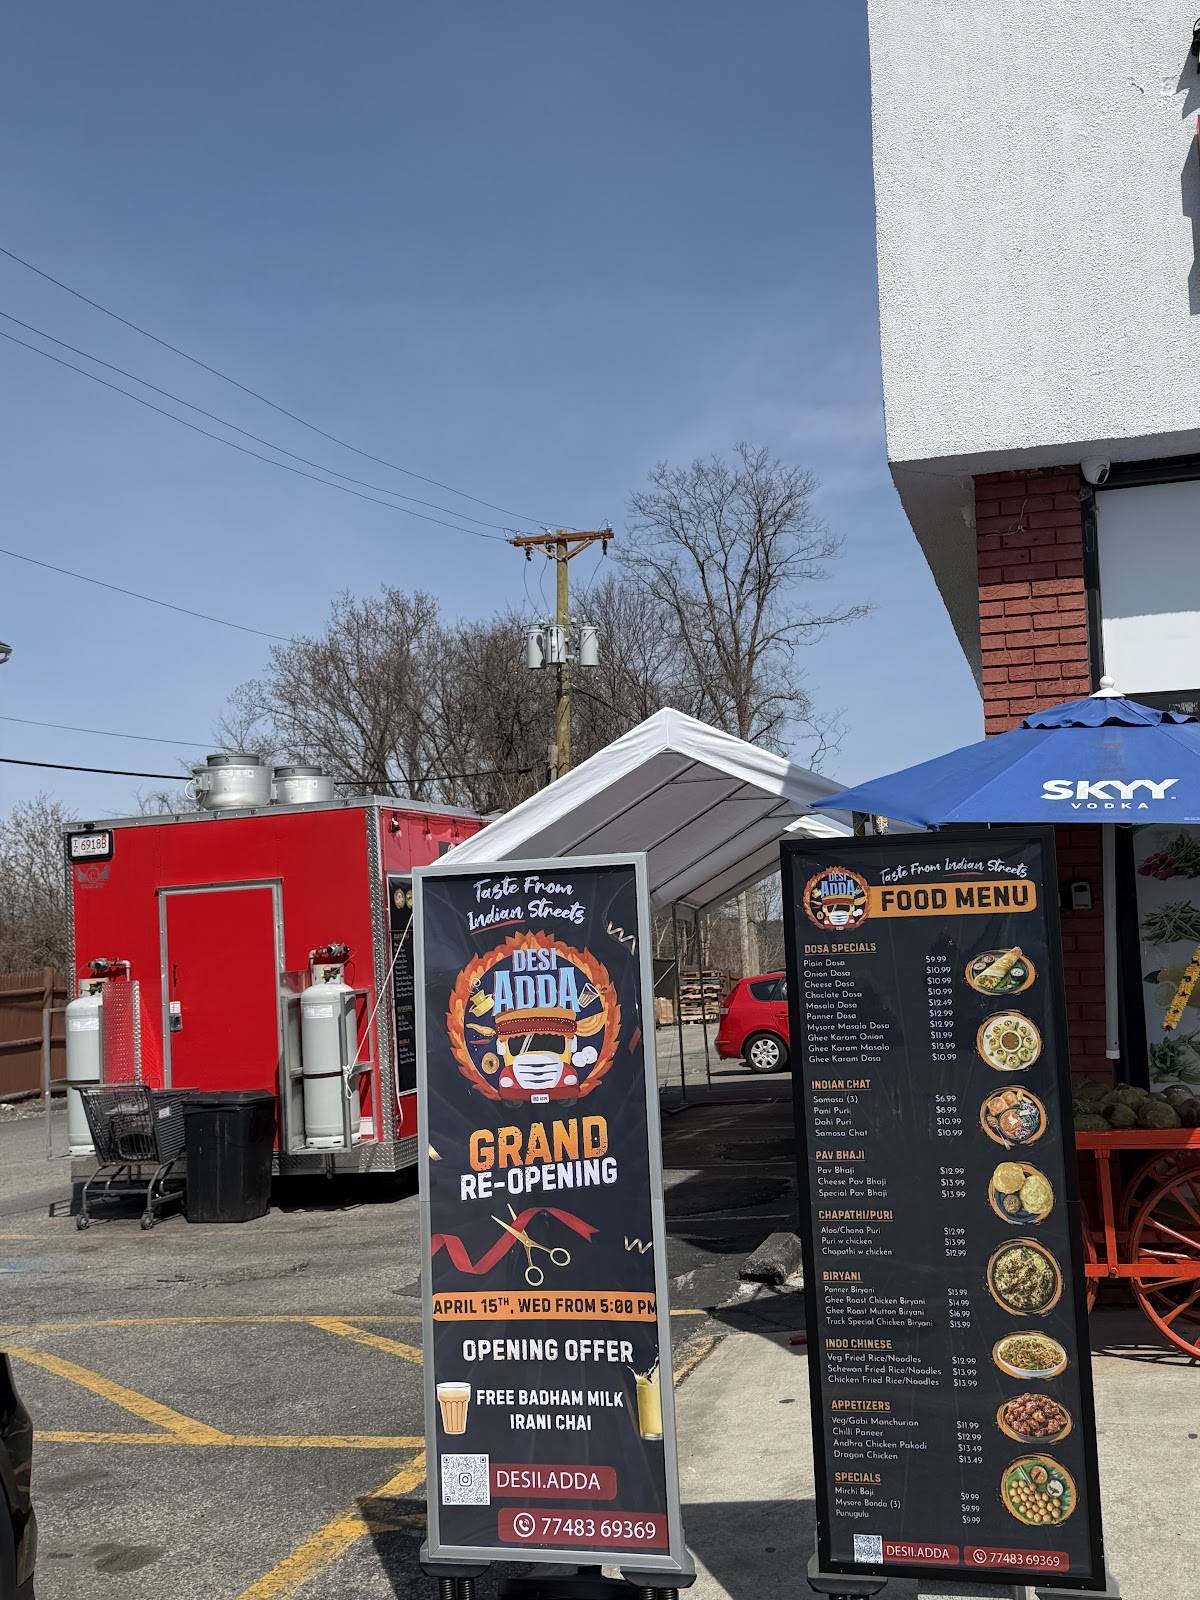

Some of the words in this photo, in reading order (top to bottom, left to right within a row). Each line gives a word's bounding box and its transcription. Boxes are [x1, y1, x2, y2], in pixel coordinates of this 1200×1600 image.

[1040, 778, 1180, 800] SKYY
[880, 866, 908, 885] Taste
[911, 863, 941, 875] From
[944, 858, 984, 871] Indian
[987, 858, 1028, 878] Streets
[828, 873, 848, 882] DESI
[473, 876, 519, 903] Taste
[524, 875, 573, 895] From
[820, 880, 855, 897] ADDA
[881, 889, 947, 911] FOOD
[956, 885, 1028, 908] MENU
[467, 909, 524, 931] Indian
[528, 898, 586, 925] Streets
[805, 945, 829, 954] DOSA
[832, 943, 876, 953] SPECIALS
[512, 948, 557, 973] DESI
[926, 955, 946, 963] $9.99
[926, 966, 950, 974] $10.99
[927, 977, 951, 985] $10.99
[492, 967, 580, 1015] ADDA
[928, 988, 952, 996] $10.99
[808, 1024, 835, 1032] Mysore
[932, 1042, 955, 1050] $12.99
[861, 1054, 880, 1062] Dosa
[933, 1053, 957, 1061] $10.99
[812, 1080, 844, 1089] INDIAN
[847, 1080, 871, 1088] CHAT
[815, 1118, 833, 1126] Dahi
[815, 1129, 845, 1137] Samosa
[849, 1129, 867, 1137] Chat
[938, 1129, 962, 1137] $10.99
[469, 1115, 609, 1172] GRAND
[816, 1151, 833, 1160] PAV
[836, 1150, 864, 1159] BHAJI
[835, 1166, 854, 1175] Bhaji
[940, 1167, 964, 1175] $12.99
[460, 1158, 617, 1200] RE-OPENING
[867, 1178, 886, 1186] Bhaji
[819, 1189, 847, 1198] Special
[868, 1189, 887, 1197] Bhaji
[819, 1210, 893, 1220] CHAPATHI/PURI
[866, 1248, 892, 1256] chicken
[823, 1272, 861, 1281] BIRYANI
[851, 1286, 874, 1294] Biryani
[847, 1296, 866, 1304] Roast
[900, 1297, 925, 1305] Biryani
[433, 1299, 477, 1314] APRIL
[518, 1298, 550, 1313] WED
[555, 1299, 596, 1313] FROM
[600, 1298, 633, 1314] 5:00
[638, 1299, 656, 1315] PM
[899, 1308, 924, 1316] Biryani
[849, 1318, 874, 1326] Special
[877, 1318, 905, 1326] Chicken
[908, 1319, 932, 1327] Biryani
[826, 1339, 848, 1348] INDO
[851, 1339, 892, 1349] CHINESE
[463, 1339, 558, 1361] OPENING
[565, 1340, 633, 1363] OFFER
[827, 1354, 842, 1362] Veg
[869, 1354, 921, 1363] Rice/Noodles
[889, 1366, 941, 1375] Rice/Noodles
[828, 1375, 859, 1383] Chicken
[886, 1377, 939, 1386] Rice/Noodles
[477, 1390, 514, 1405] FREE
[519, 1390, 583, 1407] BADHAM
[587, 1391, 623, 1407] MILK
[832, 1400, 890, 1410] APPETIZERS
[510, 1414, 551, 1429] IRANI
[555, 1415, 591, 1431] CHAI
[871, 1418, 918, 1426] Manchurian
[958, 1432, 981, 1440] $12.99
[834, 1450, 863, 1459] Dragon
[867, 1451, 898, 1459] Chicken
[497, 1471, 600, 1490] DESII.ADDA
[834, 1472, 881, 1483] SPECIALS
[835, 1499, 861, 1508] Mysore
[890, 1500, 901, 1509] (3)
[542, 1517, 595, 1537] 77483
[601, 1519, 656, 1539] 69369
[886, 1545, 950, 1560] DESII.ADDA
[990, 1552, 1023, 1565] 77483
[1026, 1554, 1060, 1567] 69369
